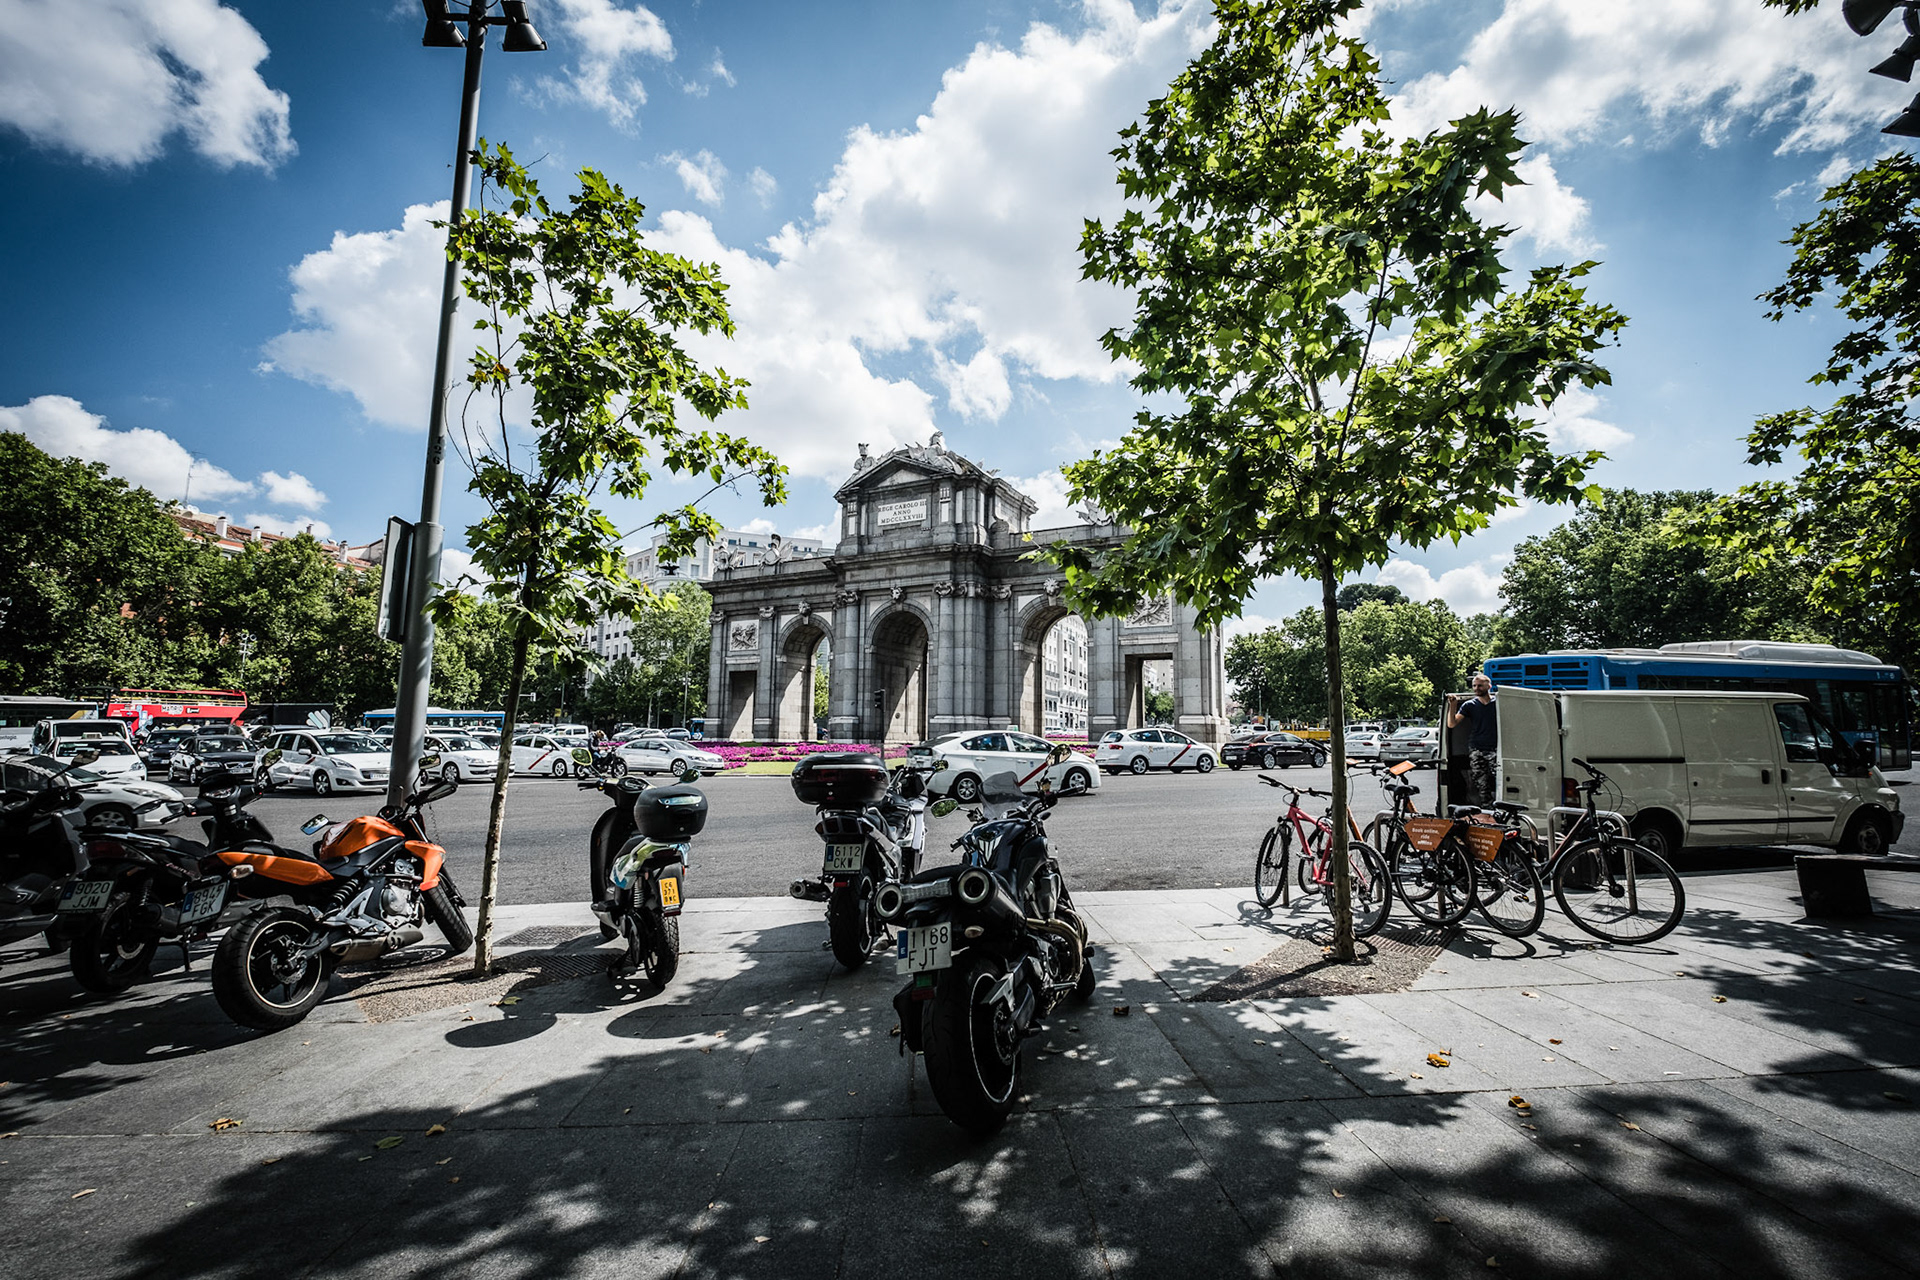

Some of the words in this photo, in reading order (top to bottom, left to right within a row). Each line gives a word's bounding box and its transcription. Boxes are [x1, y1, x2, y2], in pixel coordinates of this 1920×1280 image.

[835, 846, 861, 857] 6112
[75, 882, 111, 895] 9020
[72, 895, 101, 908] JJM
[192, 899, 214, 918] FGK
[911, 926, 949, 949] 1168
[908, 946, 938, 970] FJT
